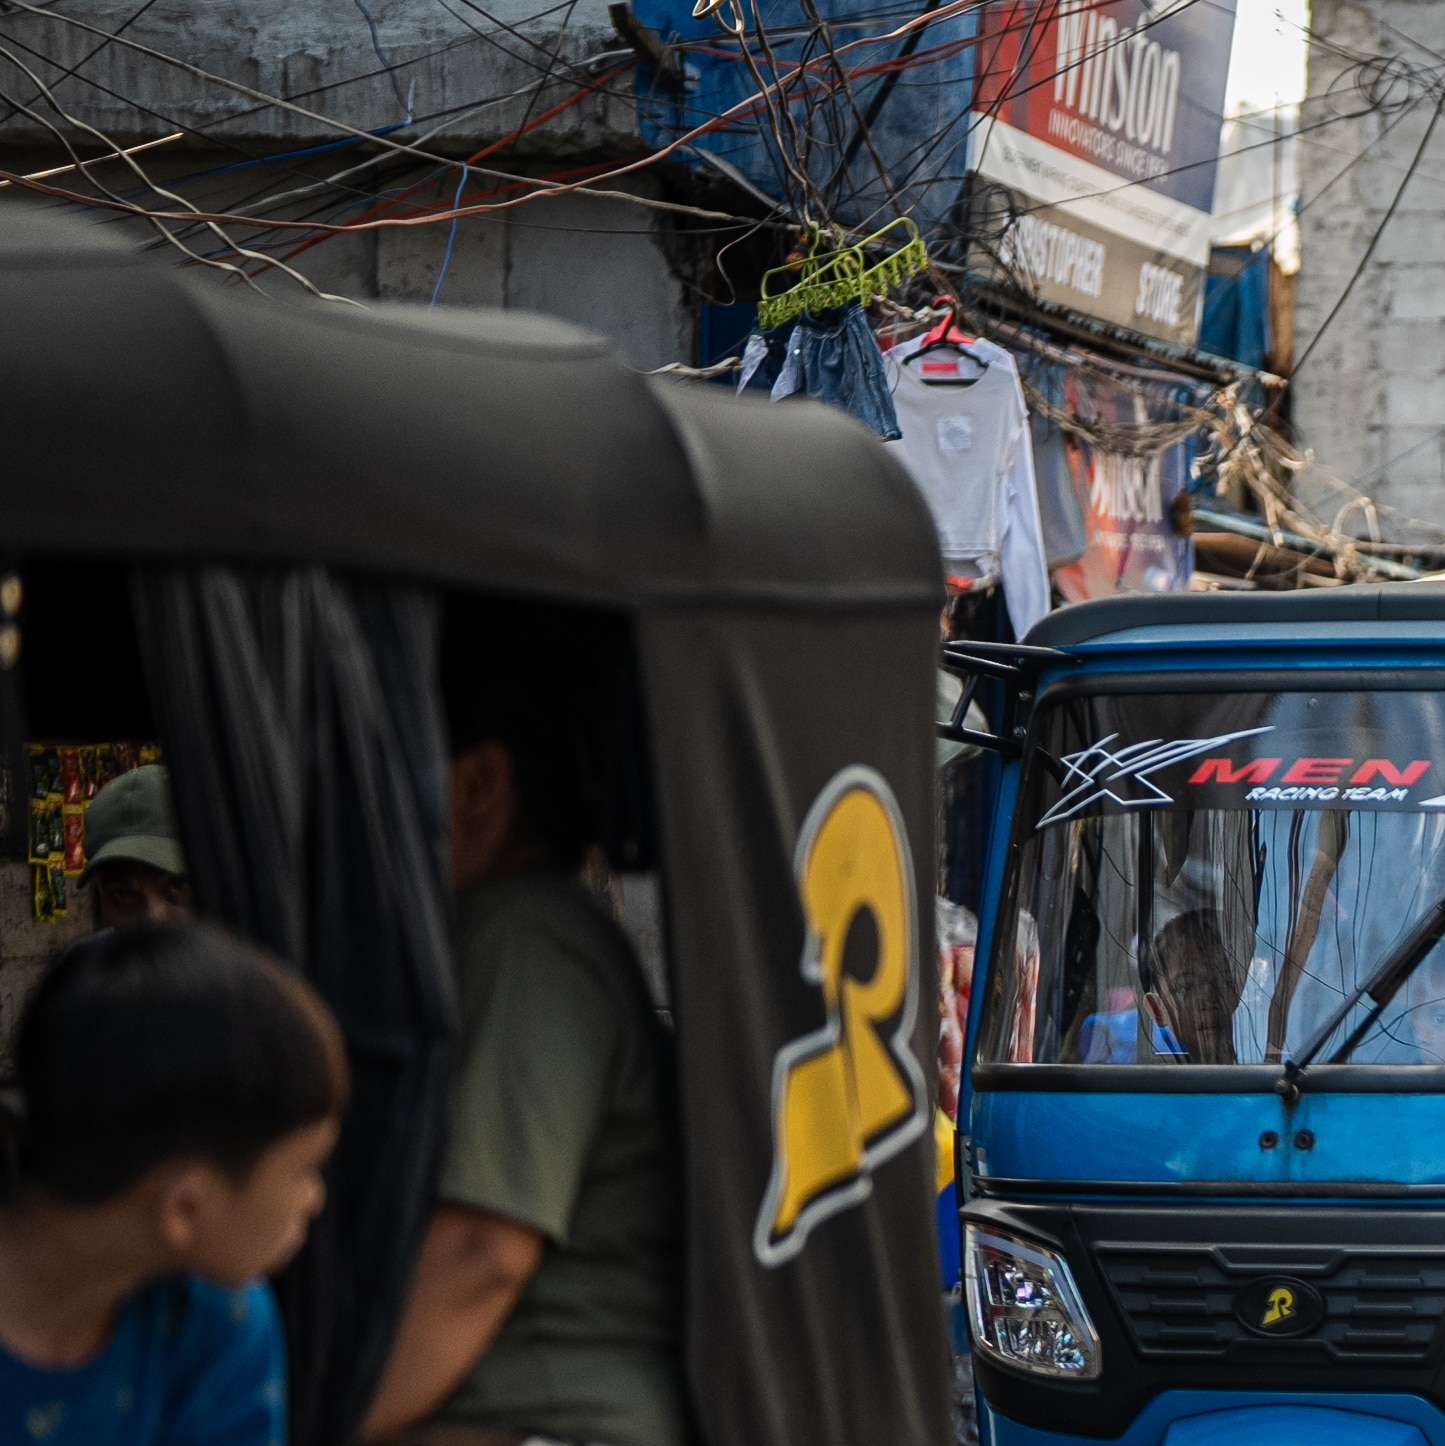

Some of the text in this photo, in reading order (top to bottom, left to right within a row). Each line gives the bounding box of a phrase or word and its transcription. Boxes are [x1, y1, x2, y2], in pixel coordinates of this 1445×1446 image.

[1054, 0, 1181, 154] Winston
[1048, 107, 1116, 162] INNOVATORS
[1115, 140, 1147, 177] SINCE
[1187, 757, 1432, 785] MEN
[1245, 786, 1409, 801] RACING TEAM
